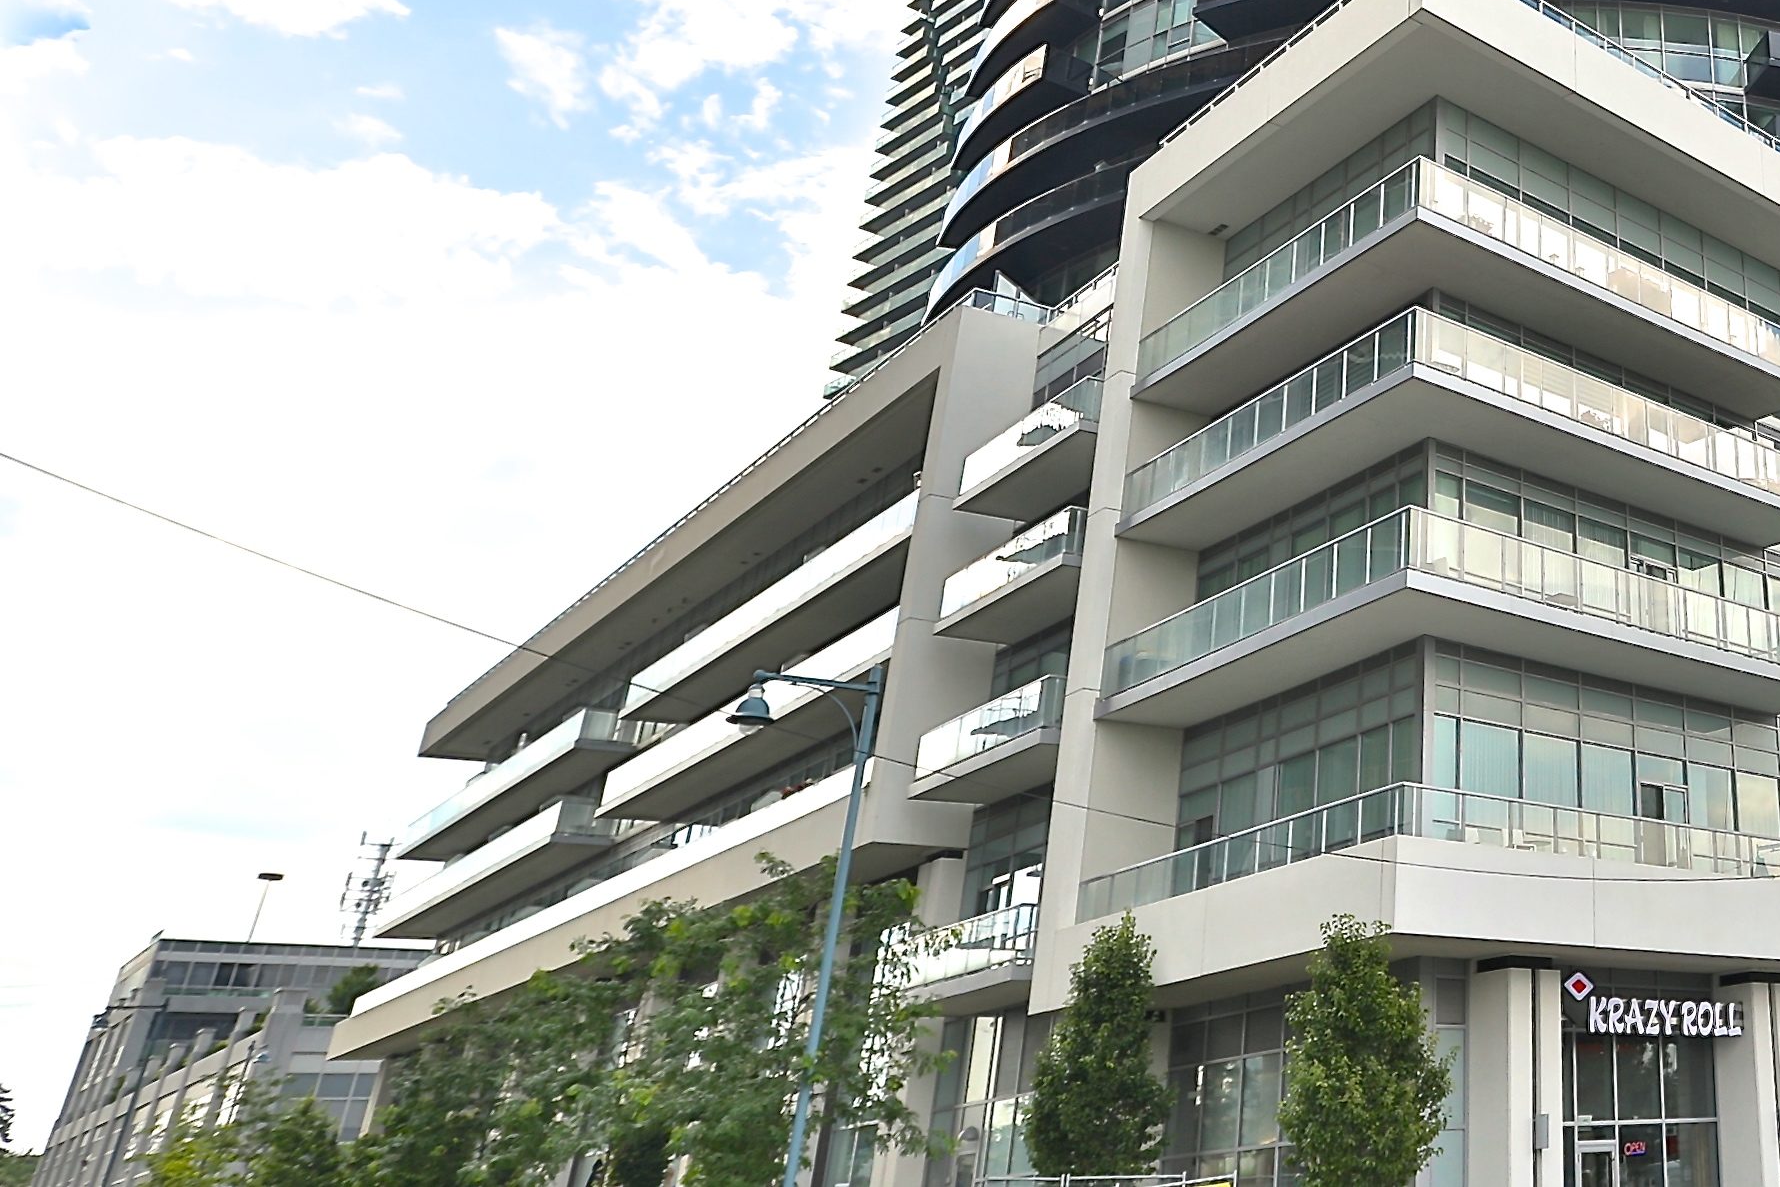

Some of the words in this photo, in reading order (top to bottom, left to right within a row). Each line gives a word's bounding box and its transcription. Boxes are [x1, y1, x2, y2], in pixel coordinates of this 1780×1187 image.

[1588, 996, 1677, 1036] KRAZY
[1681, 1000, 1742, 1037] ROLL
[1624, 1141, 1647, 1156] OPEN
